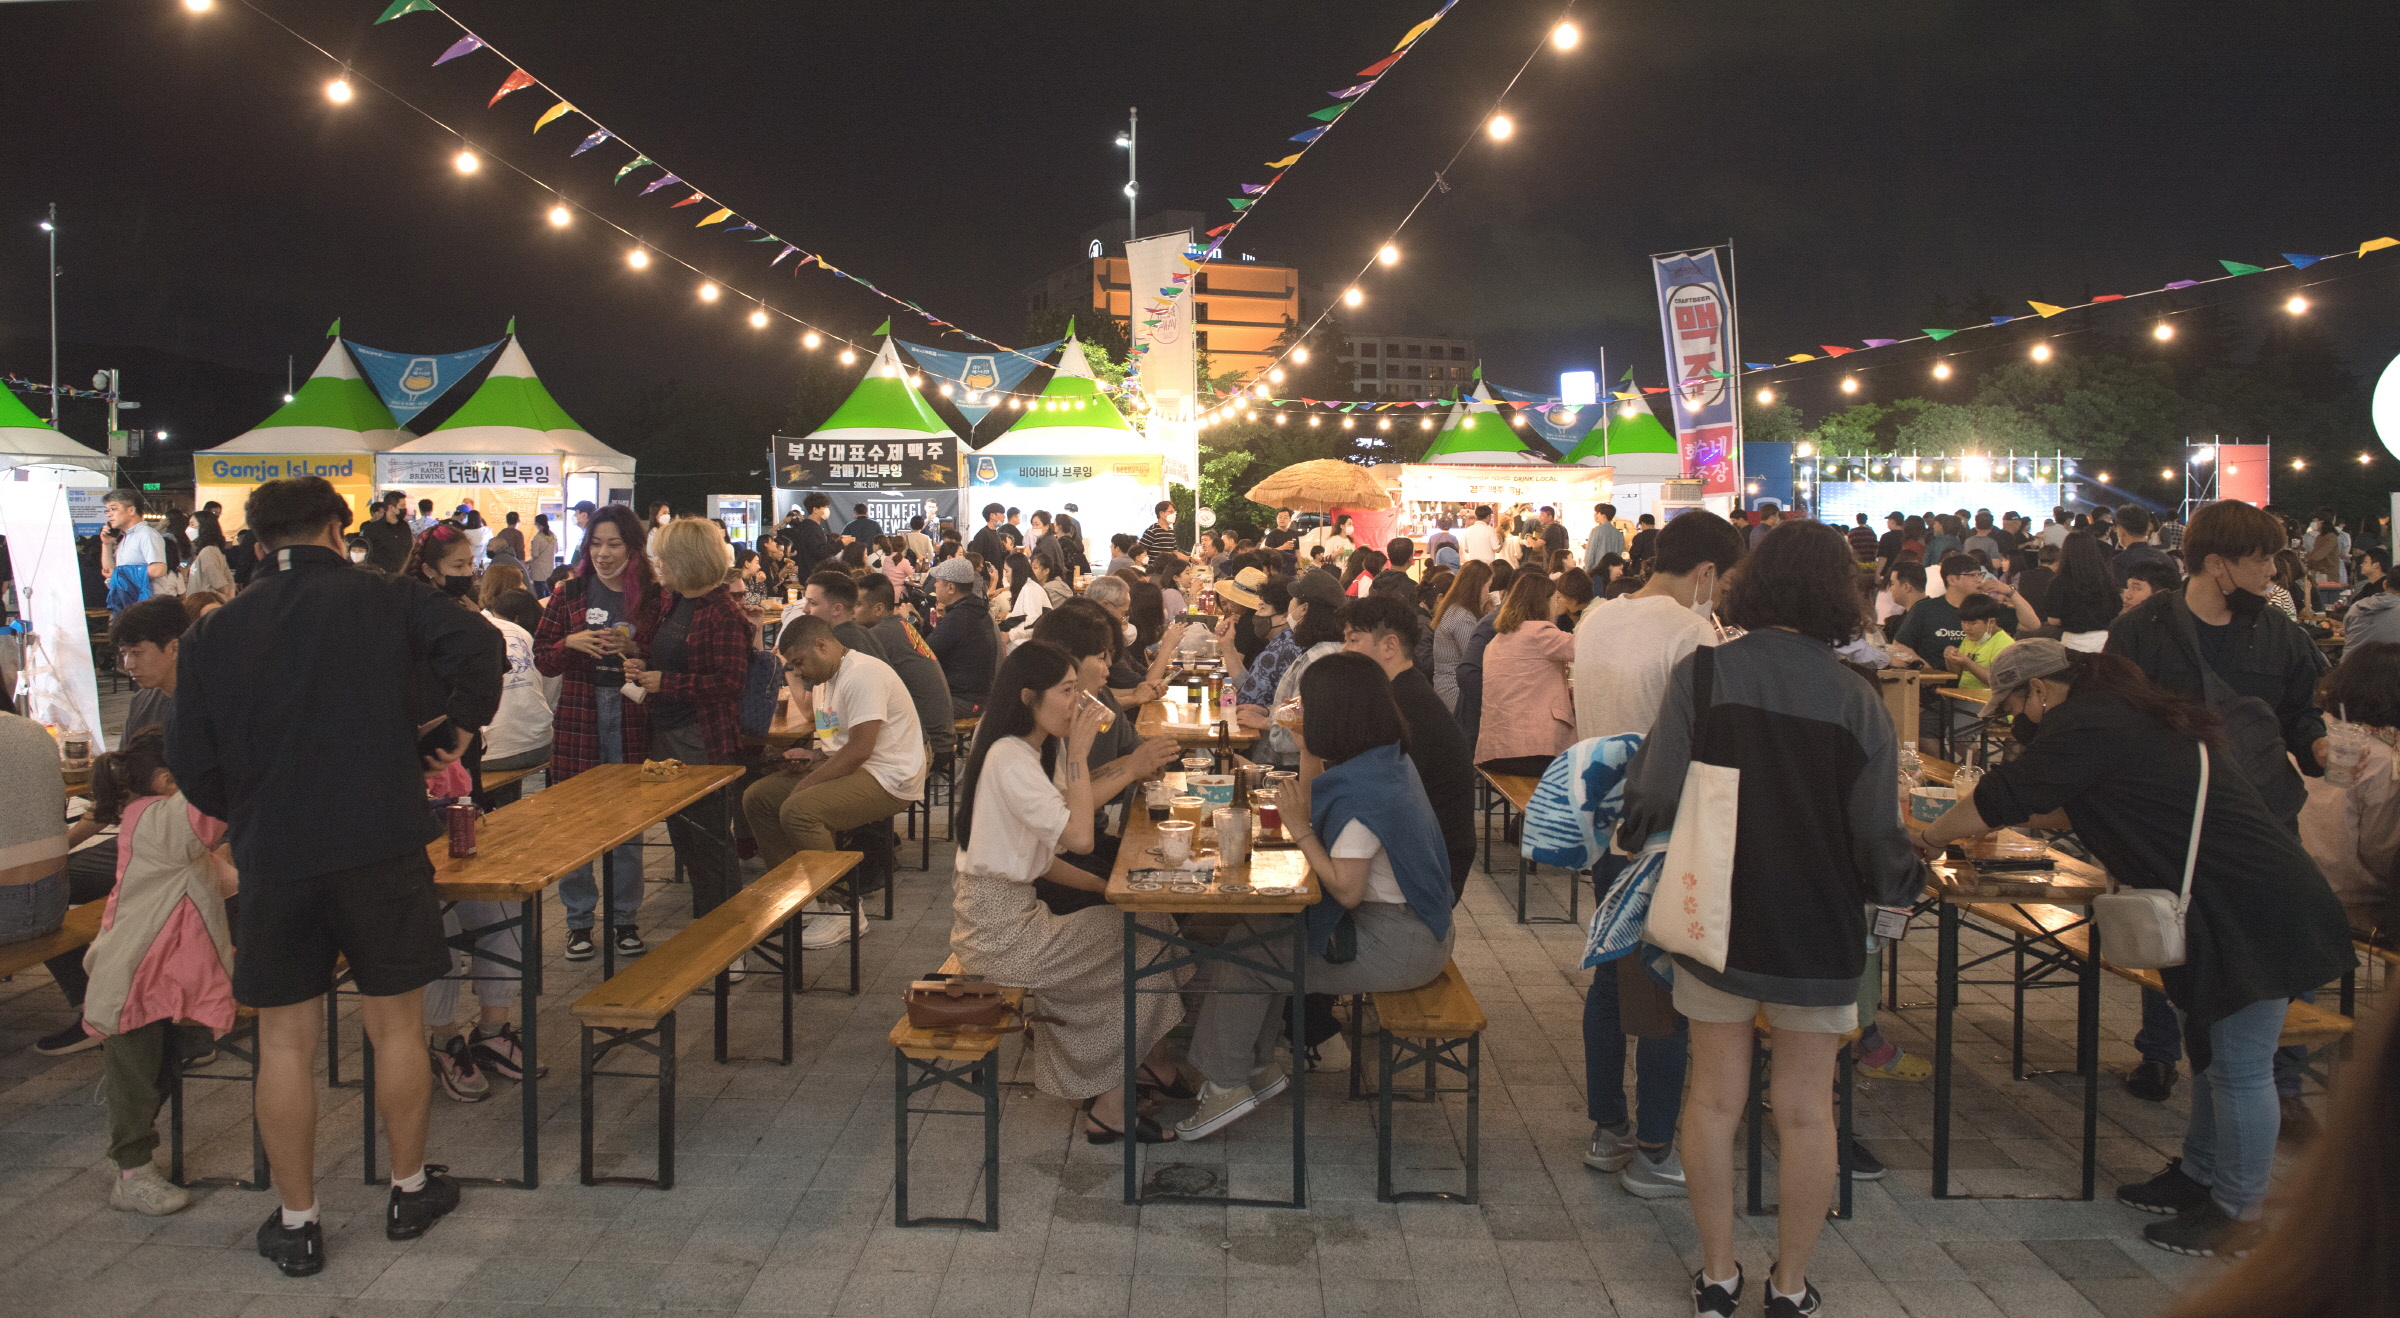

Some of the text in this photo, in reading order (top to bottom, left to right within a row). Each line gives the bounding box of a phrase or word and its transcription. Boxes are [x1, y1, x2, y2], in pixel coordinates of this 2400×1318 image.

[1674, 295, 1711, 304] CRAFTBEER
[1674, 302, 1719, 396] 맥주
[787, 442, 944, 462] 부산대표수제맥주
[212, 460, 279, 482] Gamja
[448, 465, 549, 484] 더랜치 브루잉
[829, 464, 903, 478] 갈매기브루잉
[1019, 466, 1092, 479] 비어바나 브루잉
[1687, 461, 1729, 482] 조장
[853, 481, 880, 489] SINCE 2014
[867, 503, 922, 519] GALMEGI
